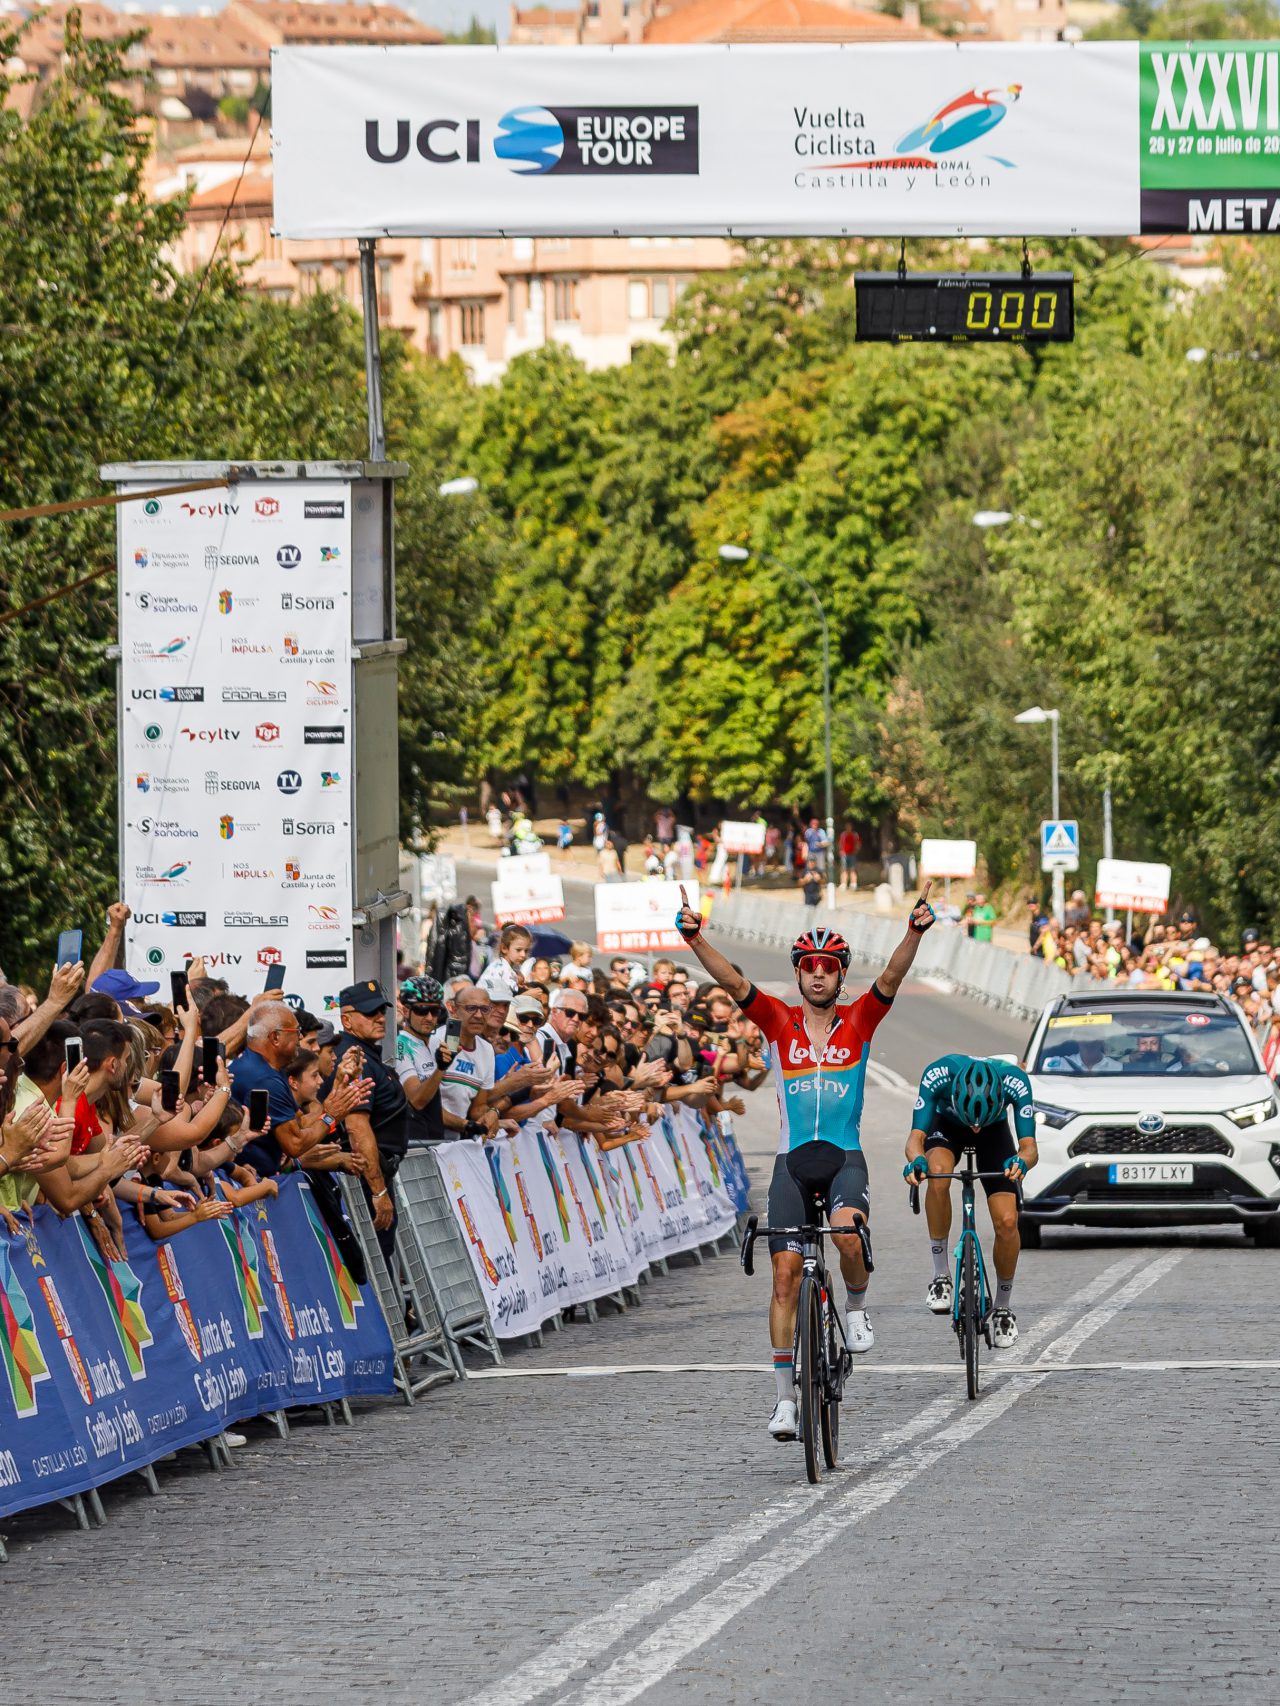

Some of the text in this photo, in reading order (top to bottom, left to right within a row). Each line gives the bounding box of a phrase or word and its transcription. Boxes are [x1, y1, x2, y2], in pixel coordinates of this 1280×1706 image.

[793, 106, 865, 129] Vuelta
[577, 116, 685, 140] EUROPE
[365, 119, 480, 163] UCI
[794, 133, 876, 156] Ciclista
[1149, 137, 1165, 154] 26
[1168, 140, 1176, 157] y
[1178, 137, 1194, 154] 27
[1197, 136, 1212, 154] de
[1215, 136, 1242, 156] julio
[1245, 136, 1260, 154] de
[578, 141, 652, 165] TOUR
[867, 160, 972, 171] INTERNACIONAL
[794, 172, 992, 191] Castilla y León
[199, 502, 239, 518] cyltv
[220, 555, 260, 566] SEGOVIA
[280, 548, 298, 561] TV
[294, 597, 335, 610] Soria
[132, 689, 156, 699] UCI
[222, 691, 287, 700] CADALSA
[199, 728, 240, 743] cyltv
[220, 781, 260, 790] SEGOVIA
[280, 774, 299, 787] TV
[155, 821, 179, 830] viajes
[296, 822, 335, 835] Soria
[154, 829, 198, 837] sanabria
[317, 881, 336, 889] León
[134, 914, 158, 924] UCI
[224, 916, 288, 924] CADALSA
[259, 953, 280, 965] Tgt
[922, 1066, 950, 1089] KERN
[788, 1076, 850, 1098] dstny
[1003, 1075, 1029, 1098] KERN
[1122, 1167, 1188, 1180] 8317 LXY
